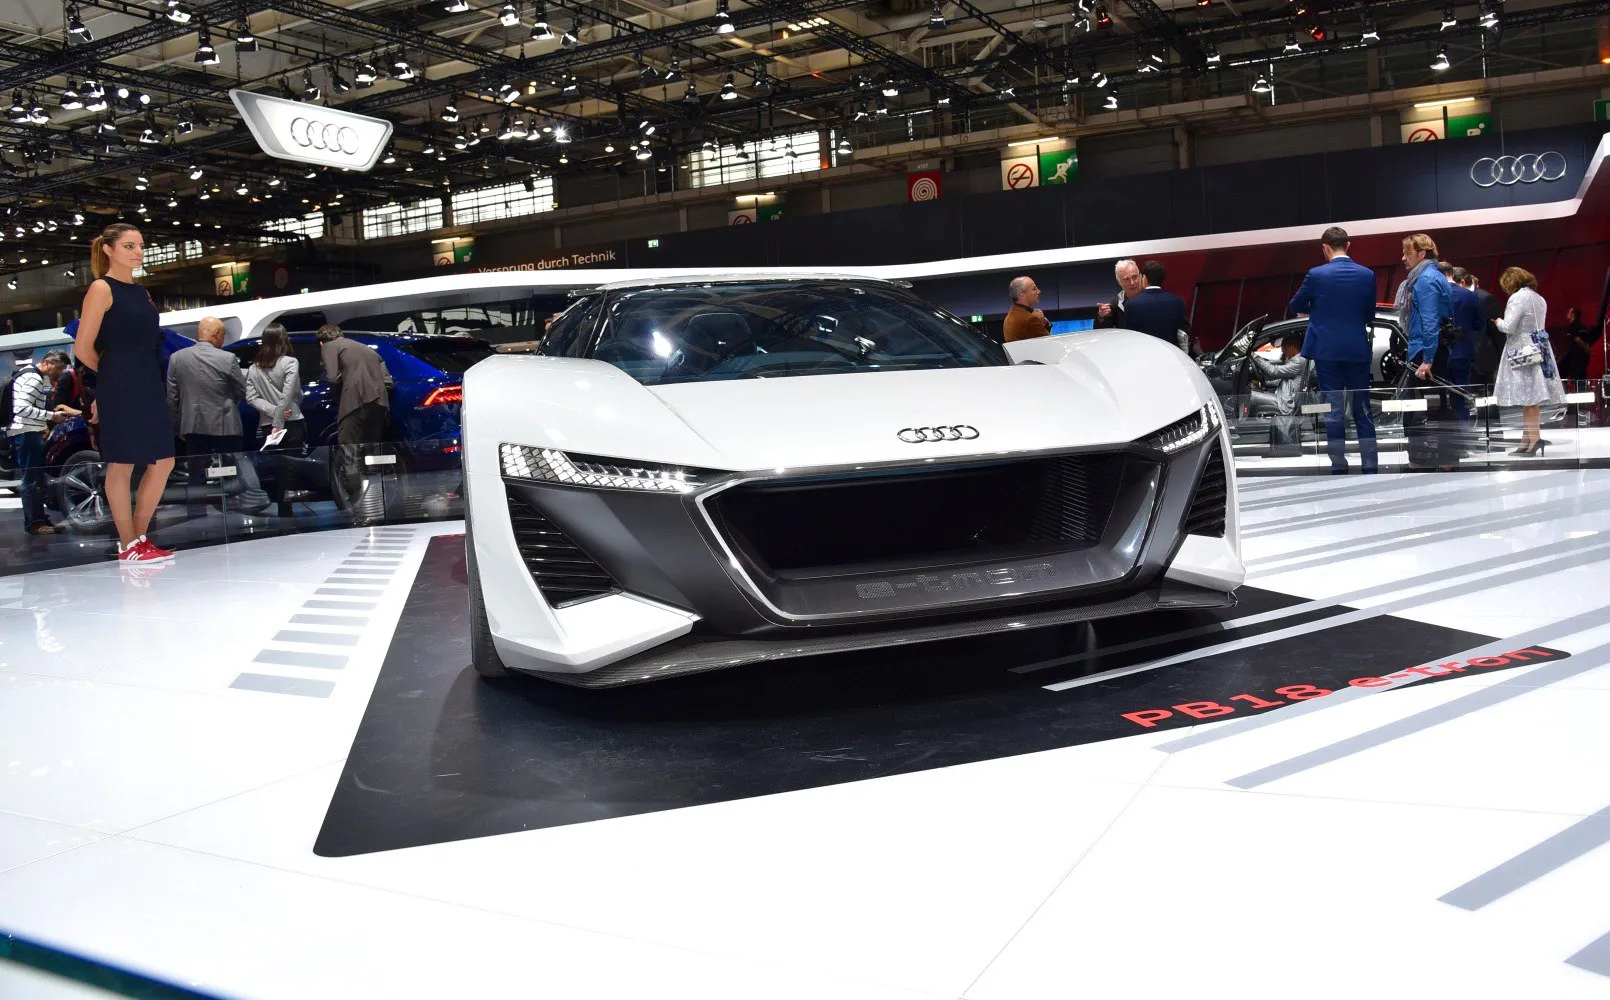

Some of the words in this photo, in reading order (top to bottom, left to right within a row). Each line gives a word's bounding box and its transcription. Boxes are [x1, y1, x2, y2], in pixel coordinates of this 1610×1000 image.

[537, 256, 569, 270] durch
[571, 250, 616, 265] Technik
[855, 563, 1058, 598] e-tron
[1121, 683, 1333, 728] PB18
[1348, 646, 1553, 688] e-tron
